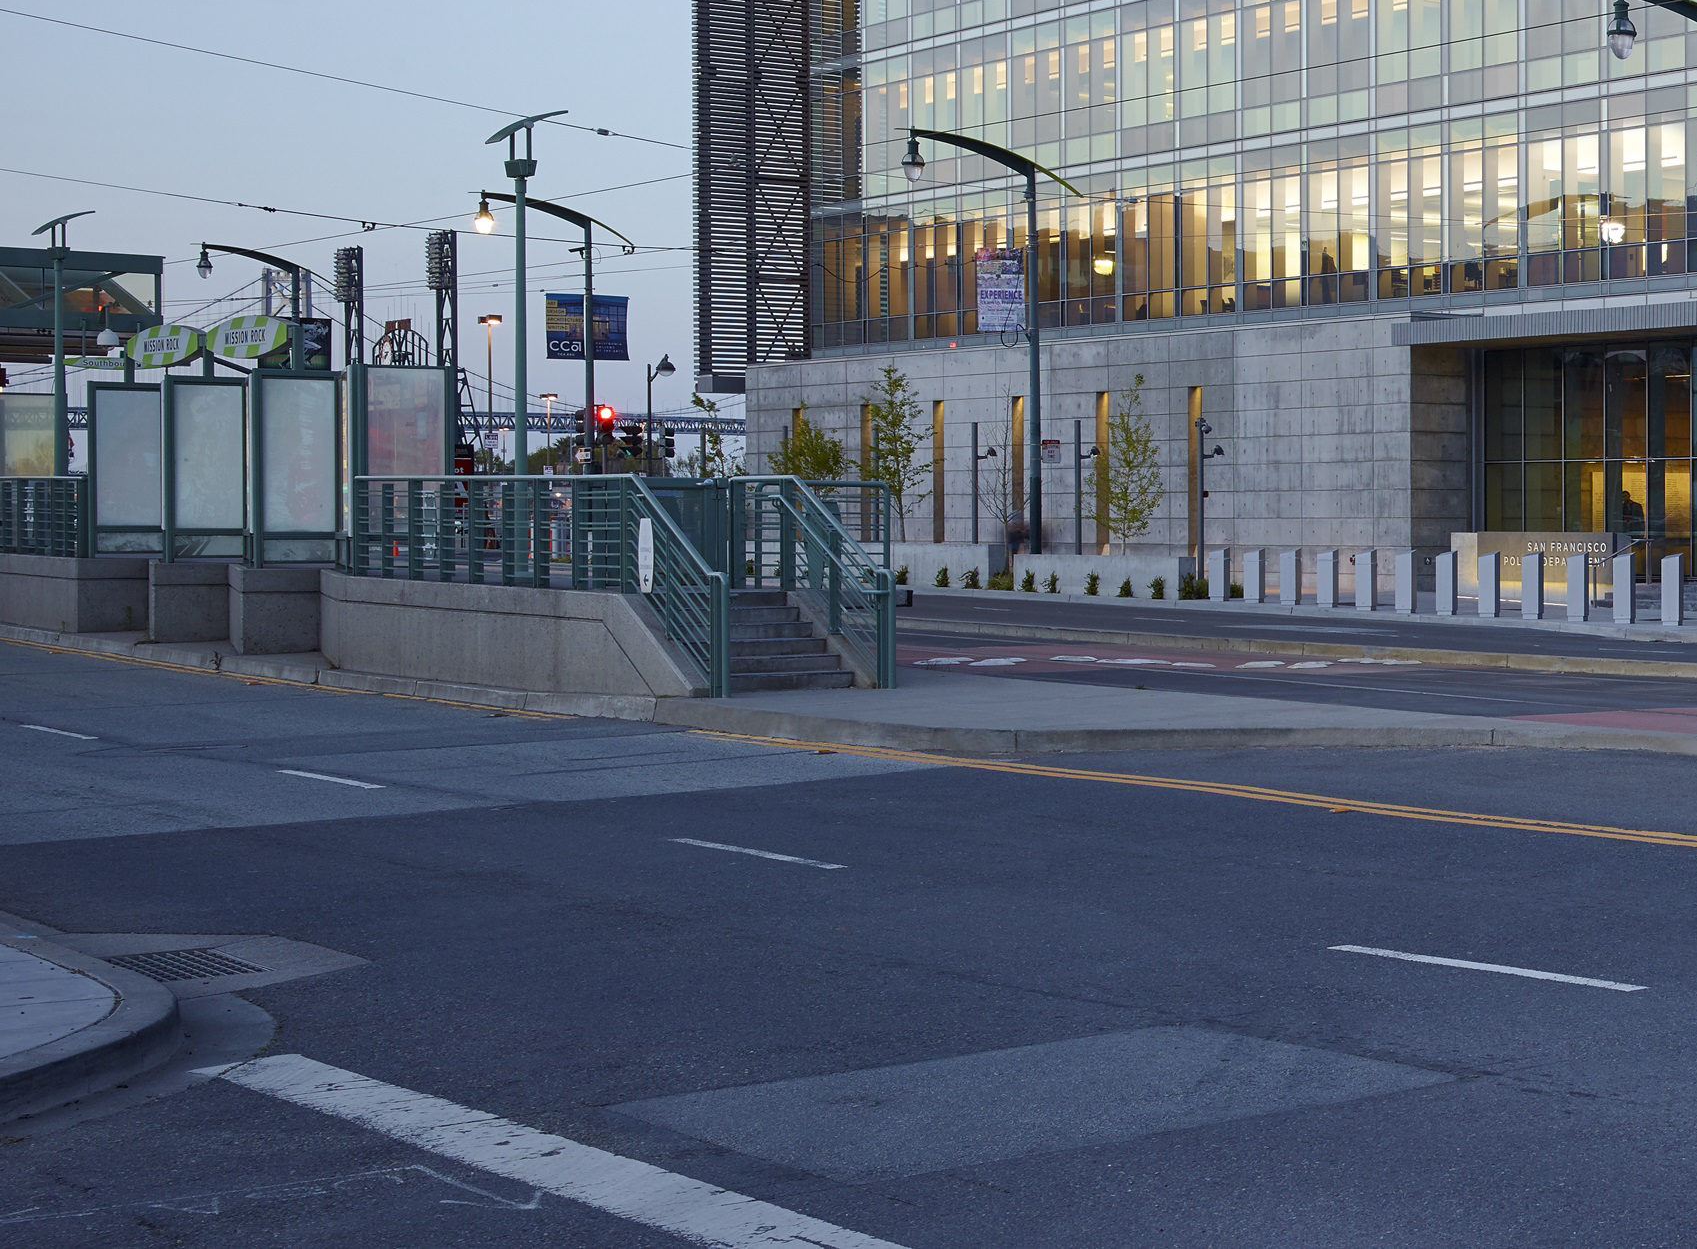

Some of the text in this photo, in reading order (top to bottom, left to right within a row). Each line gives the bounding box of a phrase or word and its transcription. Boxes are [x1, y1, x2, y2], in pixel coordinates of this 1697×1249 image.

[980, 290, 1023, 300] EXPERIENCE
[224, 328, 266, 346] MISSION ROCK
[143, 337, 180, 353] MISSION ROCK
[82, 359, 125, 367] Southbou
[1527, 542, 1607, 553] SAN FRANCISCO
